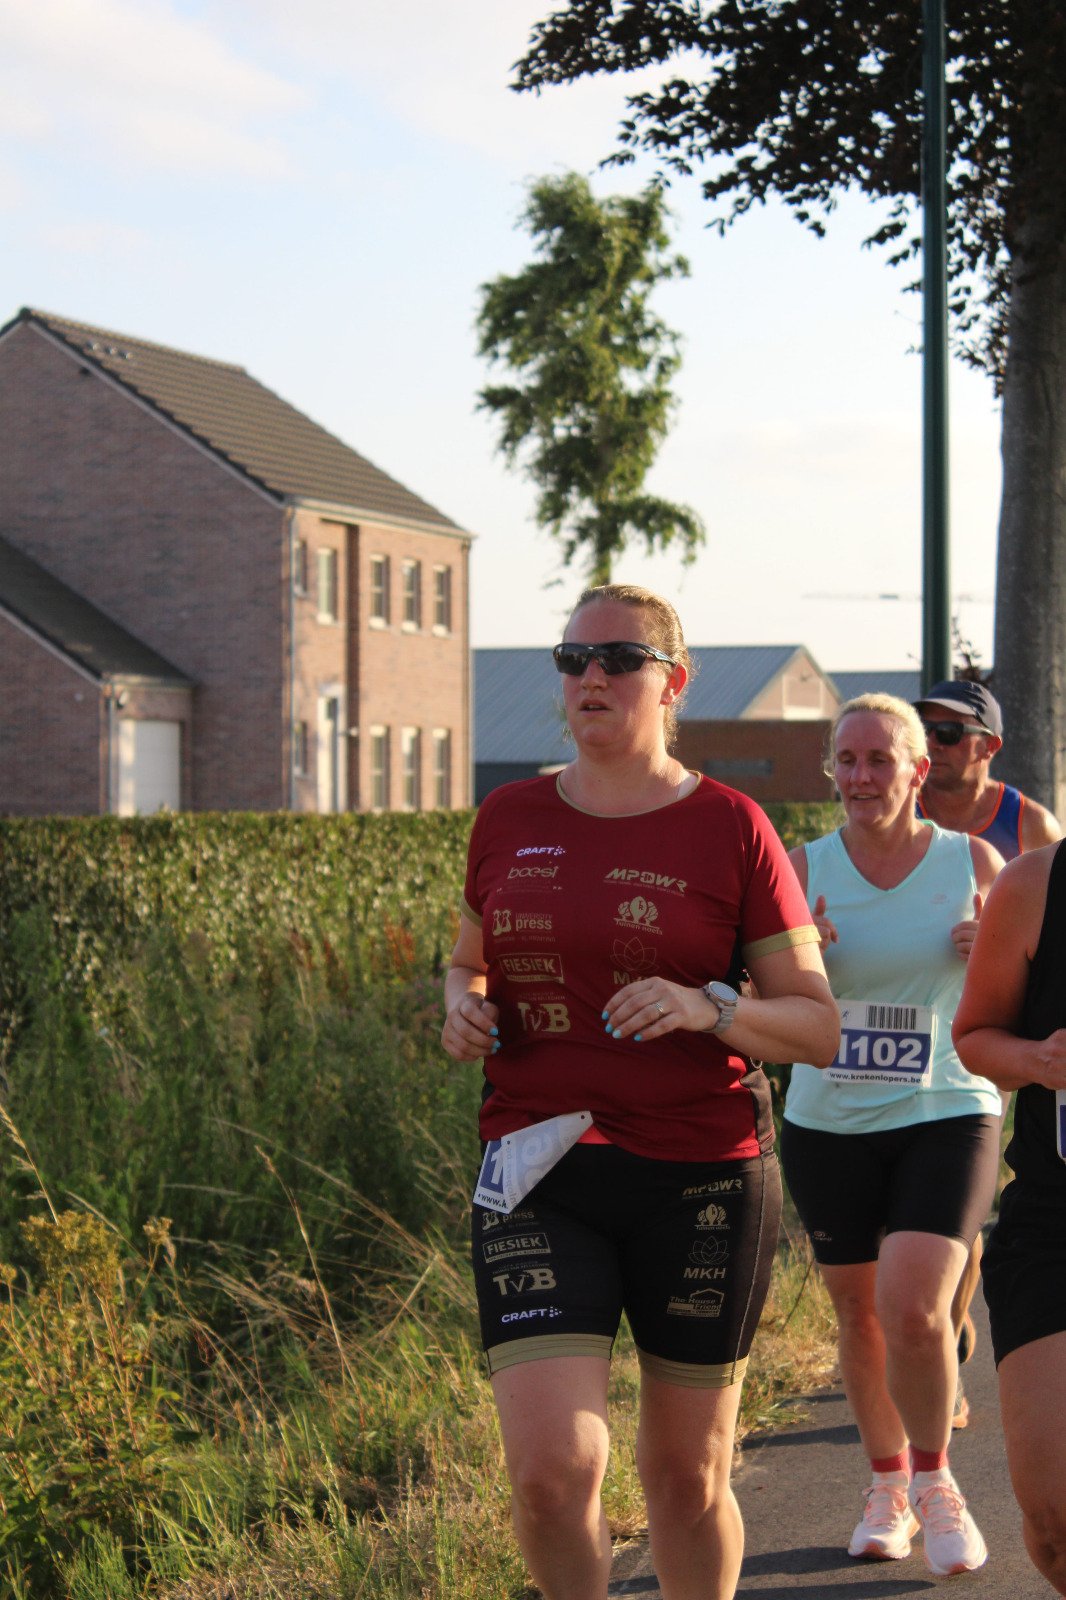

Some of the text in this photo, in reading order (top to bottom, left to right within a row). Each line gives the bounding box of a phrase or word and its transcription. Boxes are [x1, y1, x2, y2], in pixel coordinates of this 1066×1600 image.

[516, 847, 555, 857] CRAFT
[604, 868, 688, 893] MPOWR
[515, 919, 552, 932] press
[503, 958, 557, 973] FIESIEK
[838, 1034, 922, 1069] 1102
[829, 1072, 921, 1084] www.krekenlopers.be
[487, 1236, 543, 1255] FIESIEK
[683, 1267, 726, 1279] MKH
[501, 1308, 548, 1323] CRAFT
